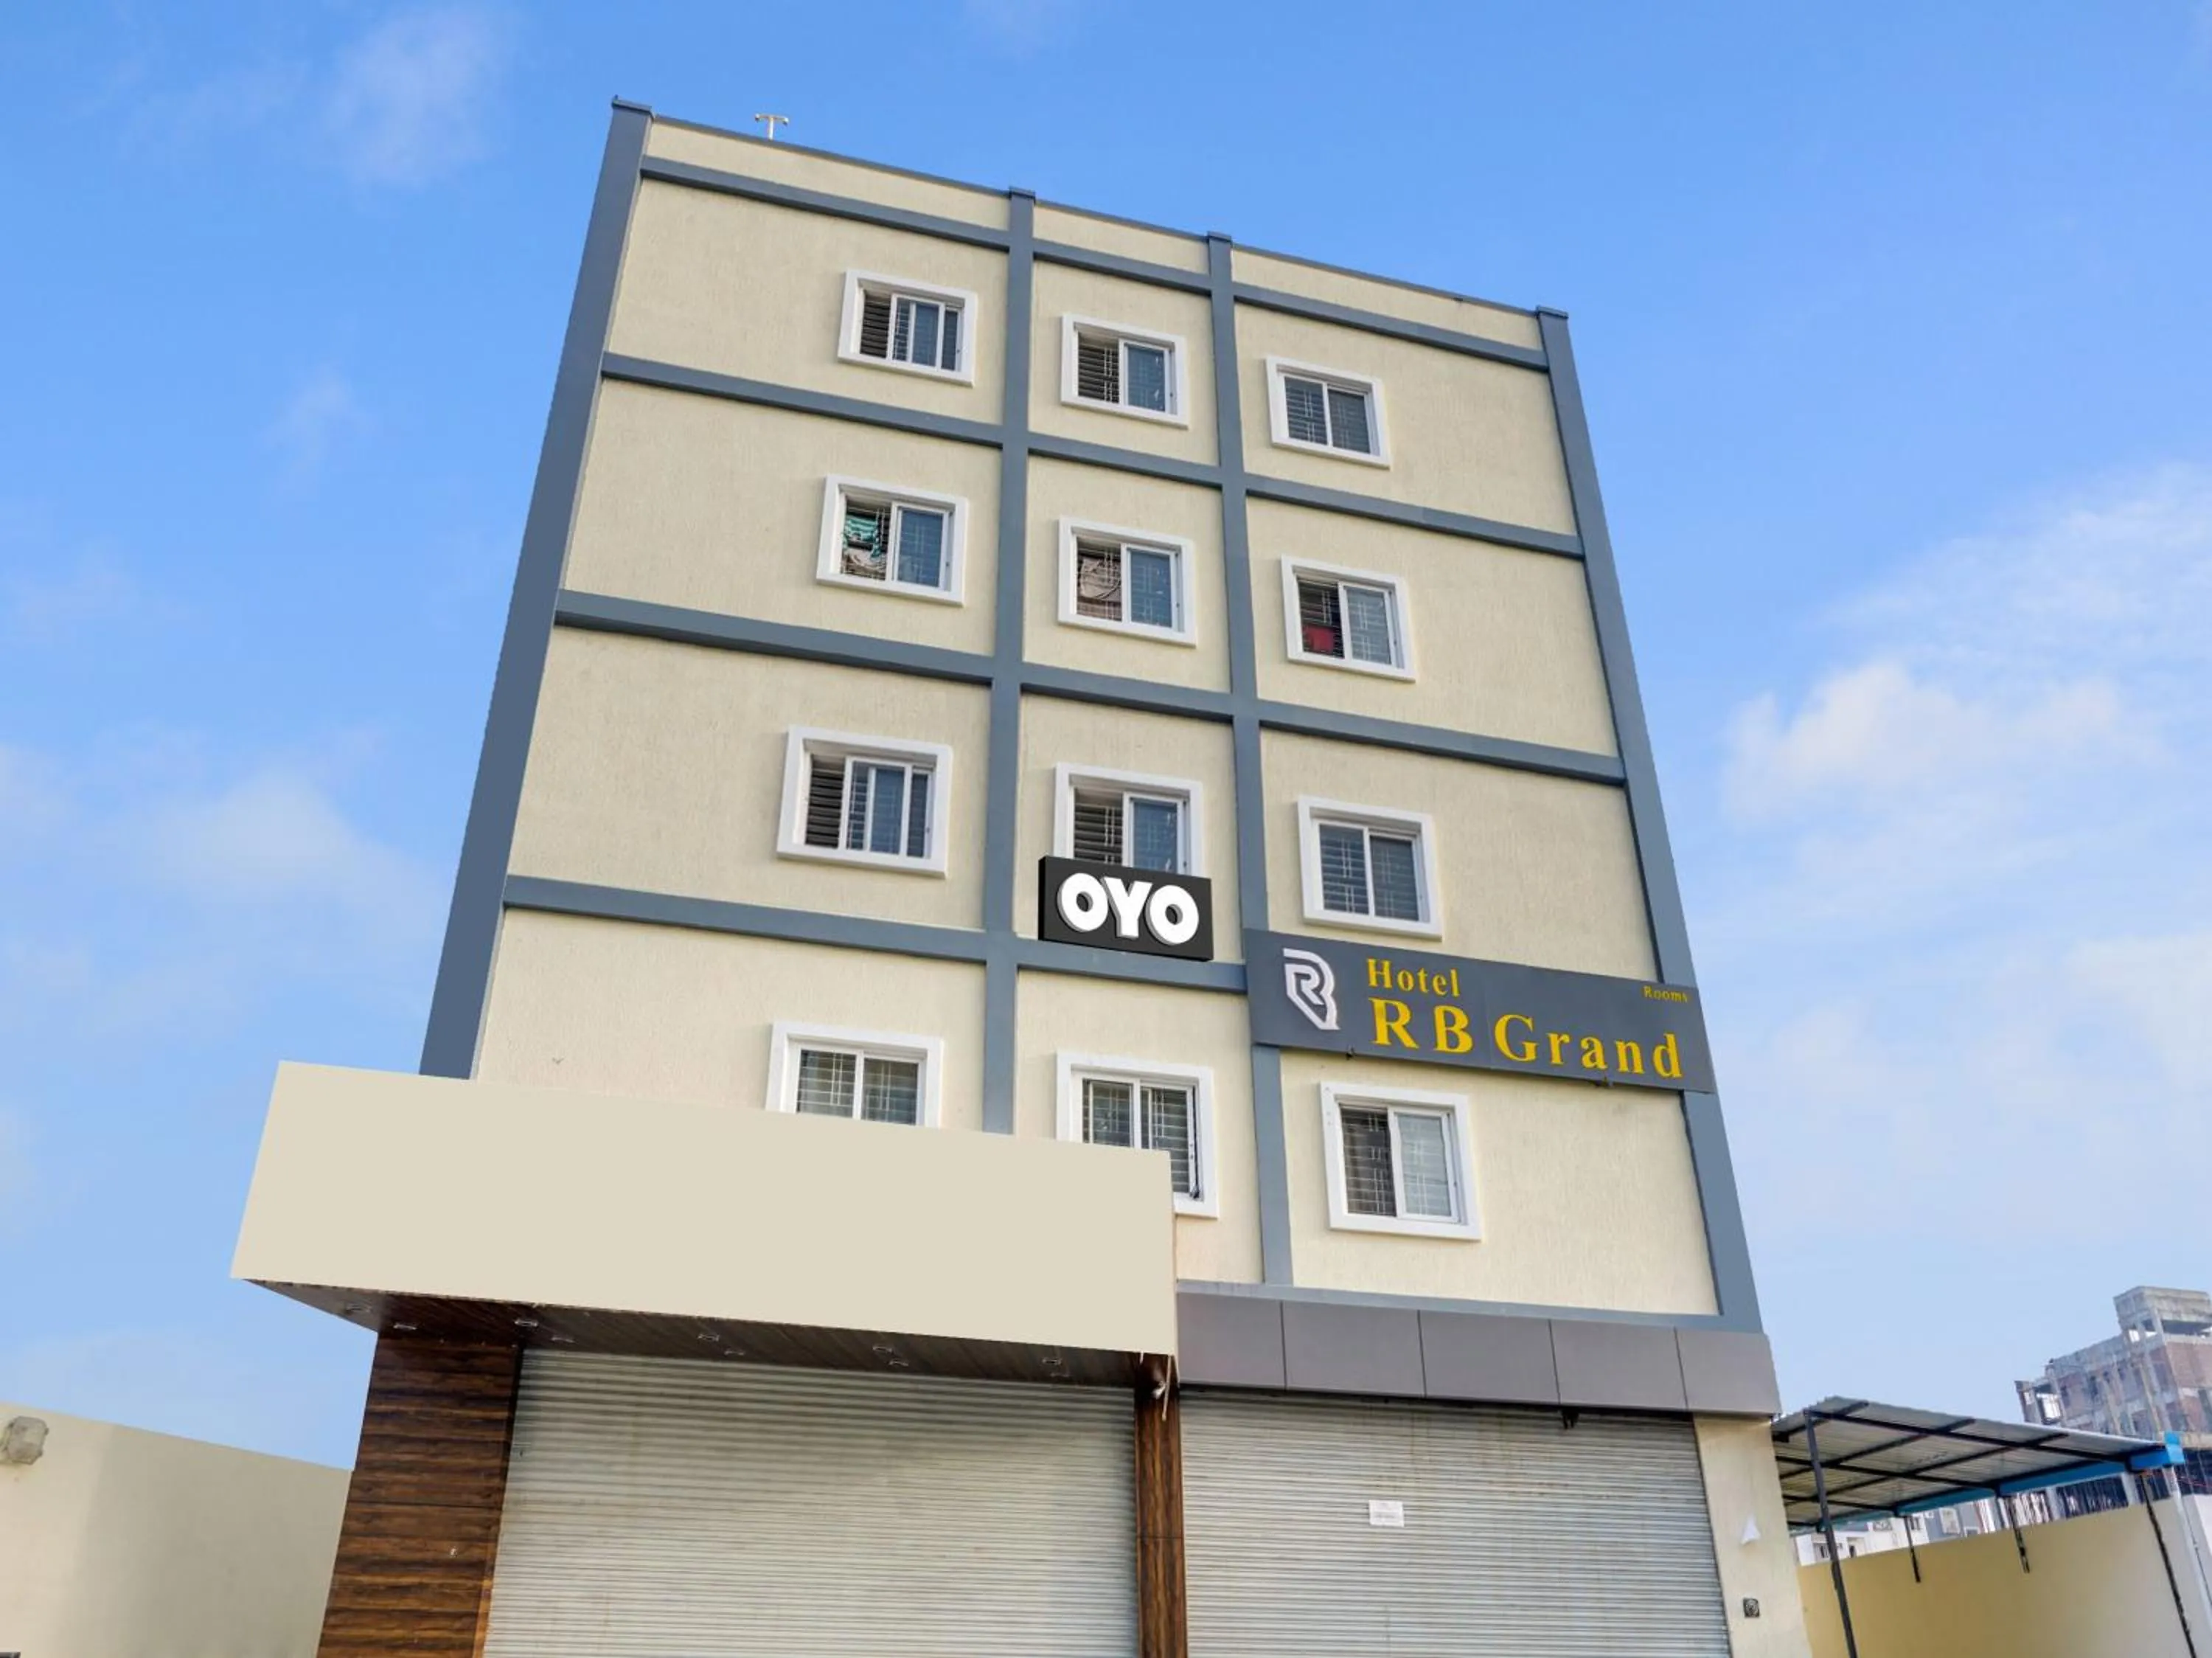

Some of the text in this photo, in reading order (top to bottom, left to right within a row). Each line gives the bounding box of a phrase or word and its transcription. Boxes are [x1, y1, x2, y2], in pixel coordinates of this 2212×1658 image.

[1057, 873, 1200, 946] OYO
[1367, 957, 1461, 998] Hotel
[1643, 985, 1688, 1002] Rooms
[1494, 1013, 1684, 1079] Grand
